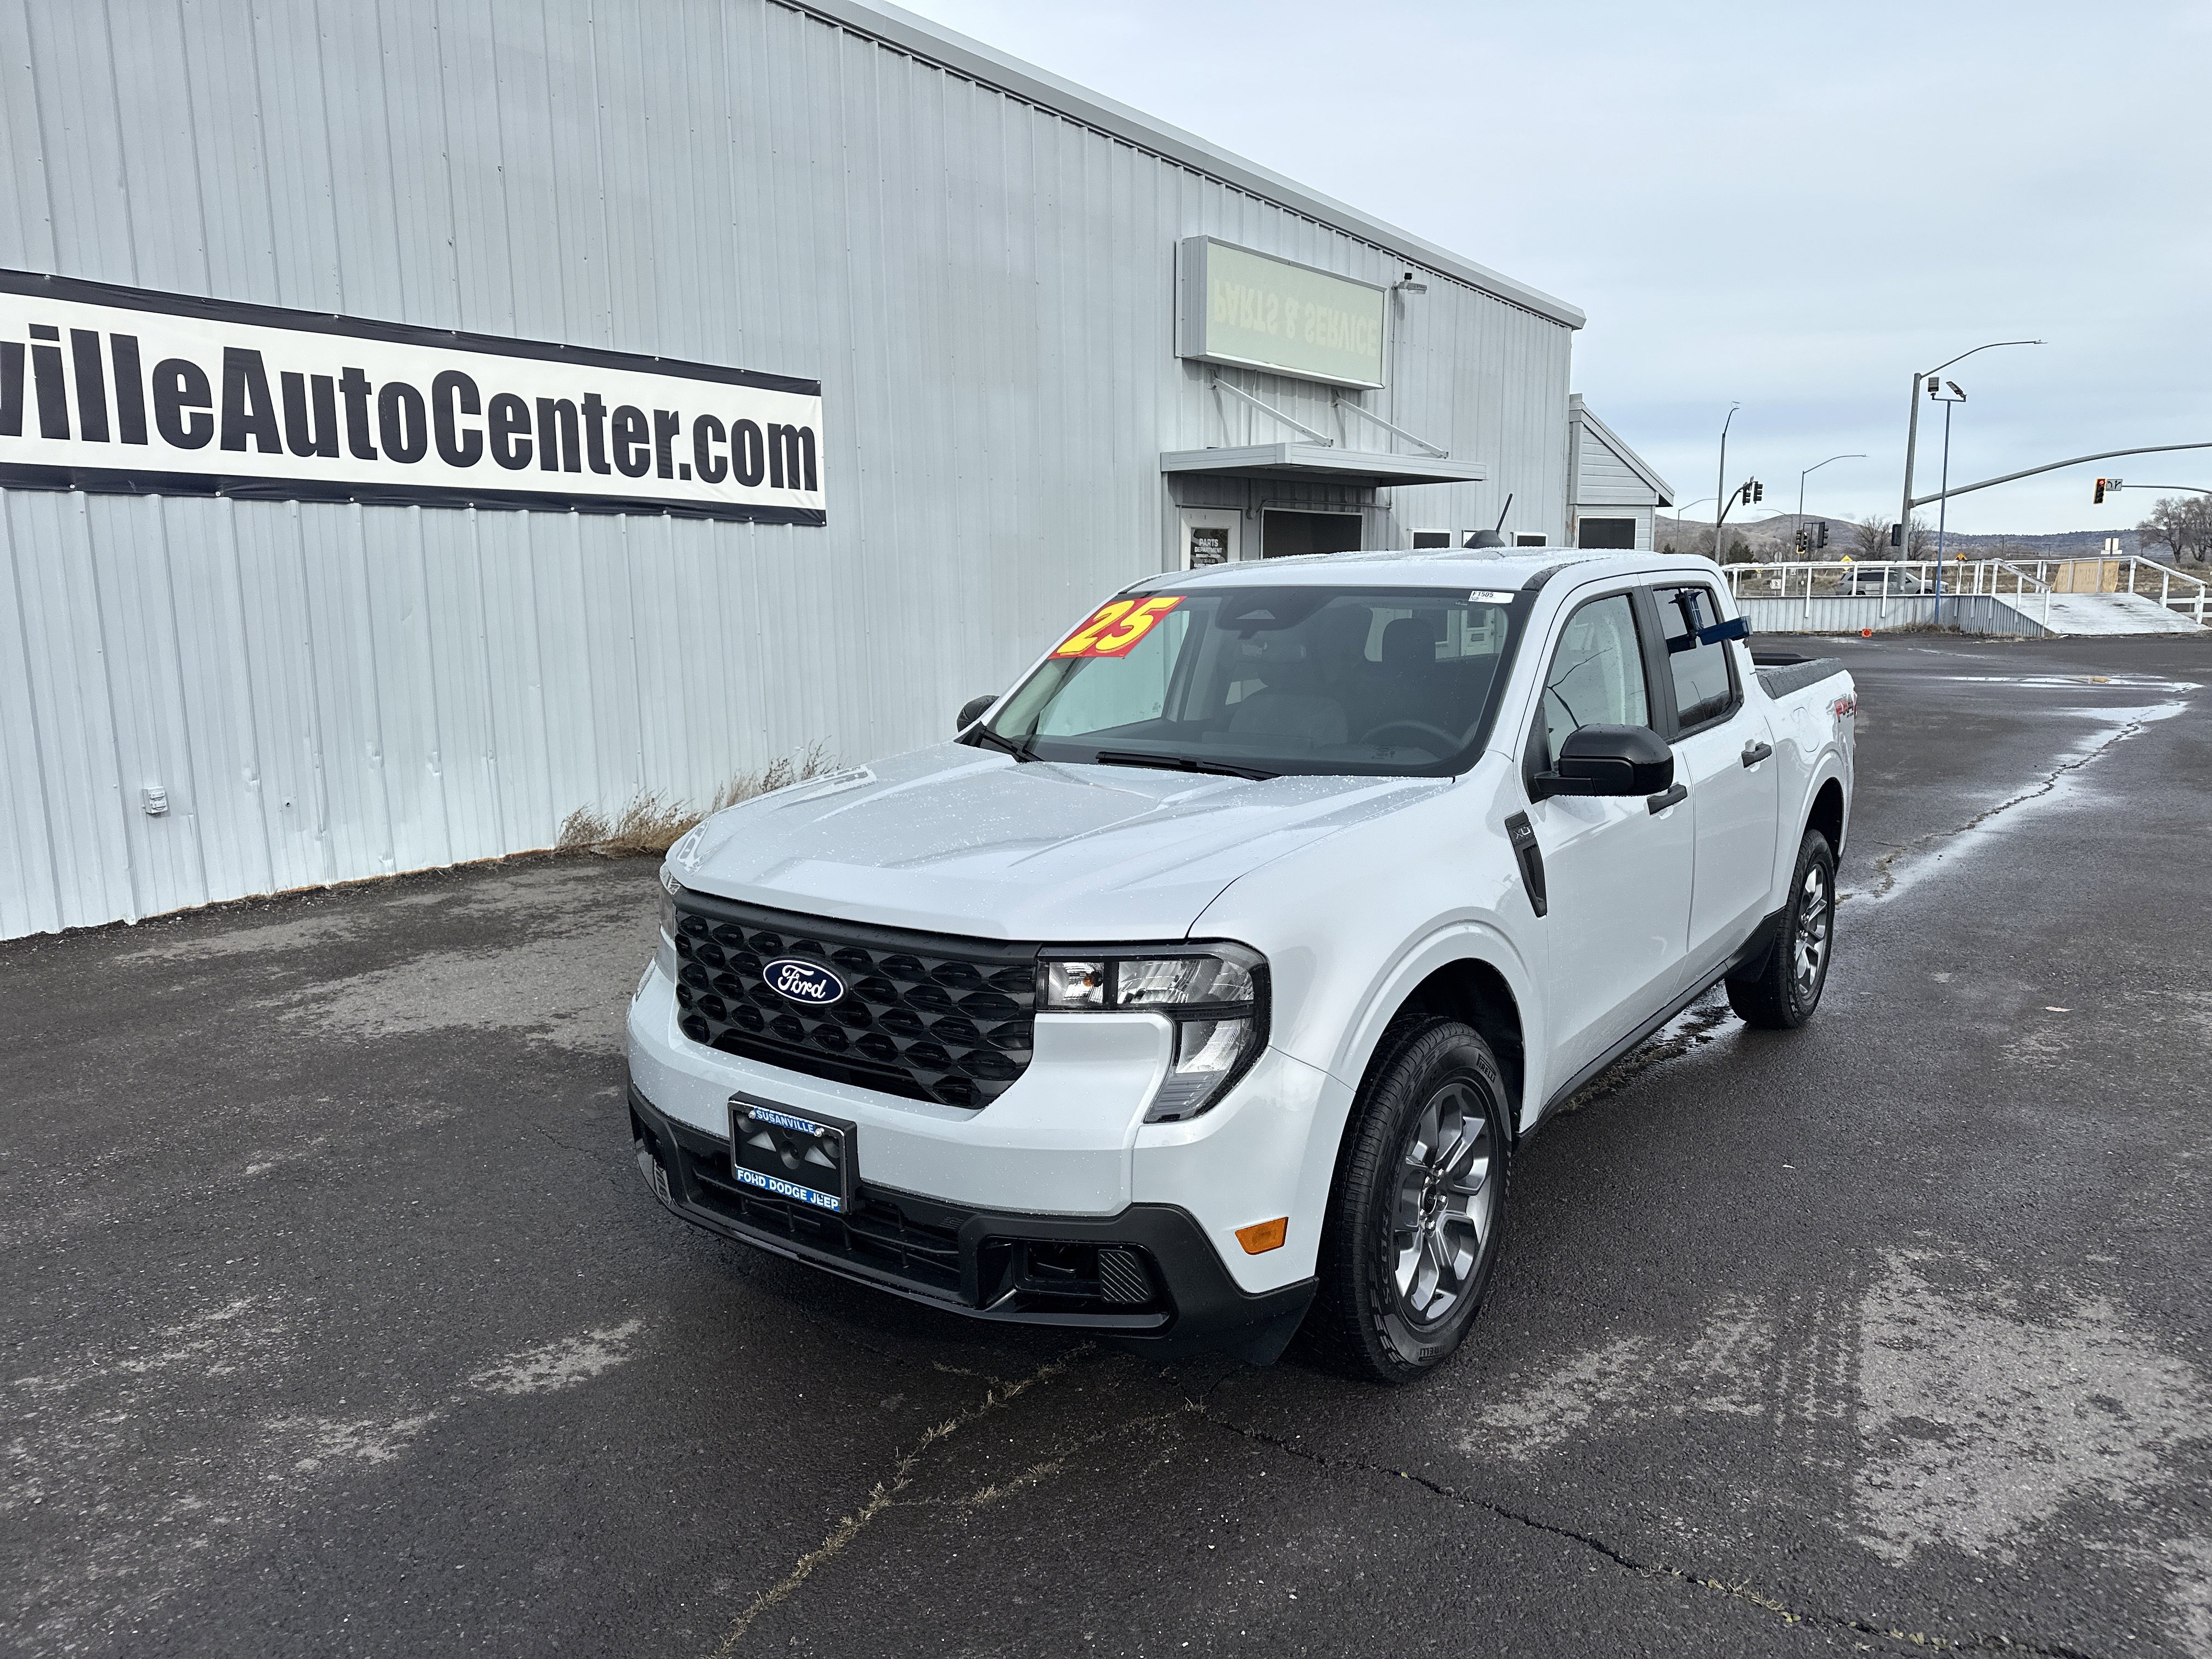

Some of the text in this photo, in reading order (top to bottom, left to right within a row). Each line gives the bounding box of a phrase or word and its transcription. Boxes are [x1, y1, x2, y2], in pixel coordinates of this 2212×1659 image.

[1199, 538, 1218, 547] PARTS
[1056, 596, 1180, 655] 25
[777, 964, 827, 998] Ford
[1476, 1053, 1496, 1084] PIRELLI
[755, 1109, 815, 1134] SUSANVILLE
[769, 1179, 807, 1201] DODGE
[810, 1193, 838, 1210] JEEP
